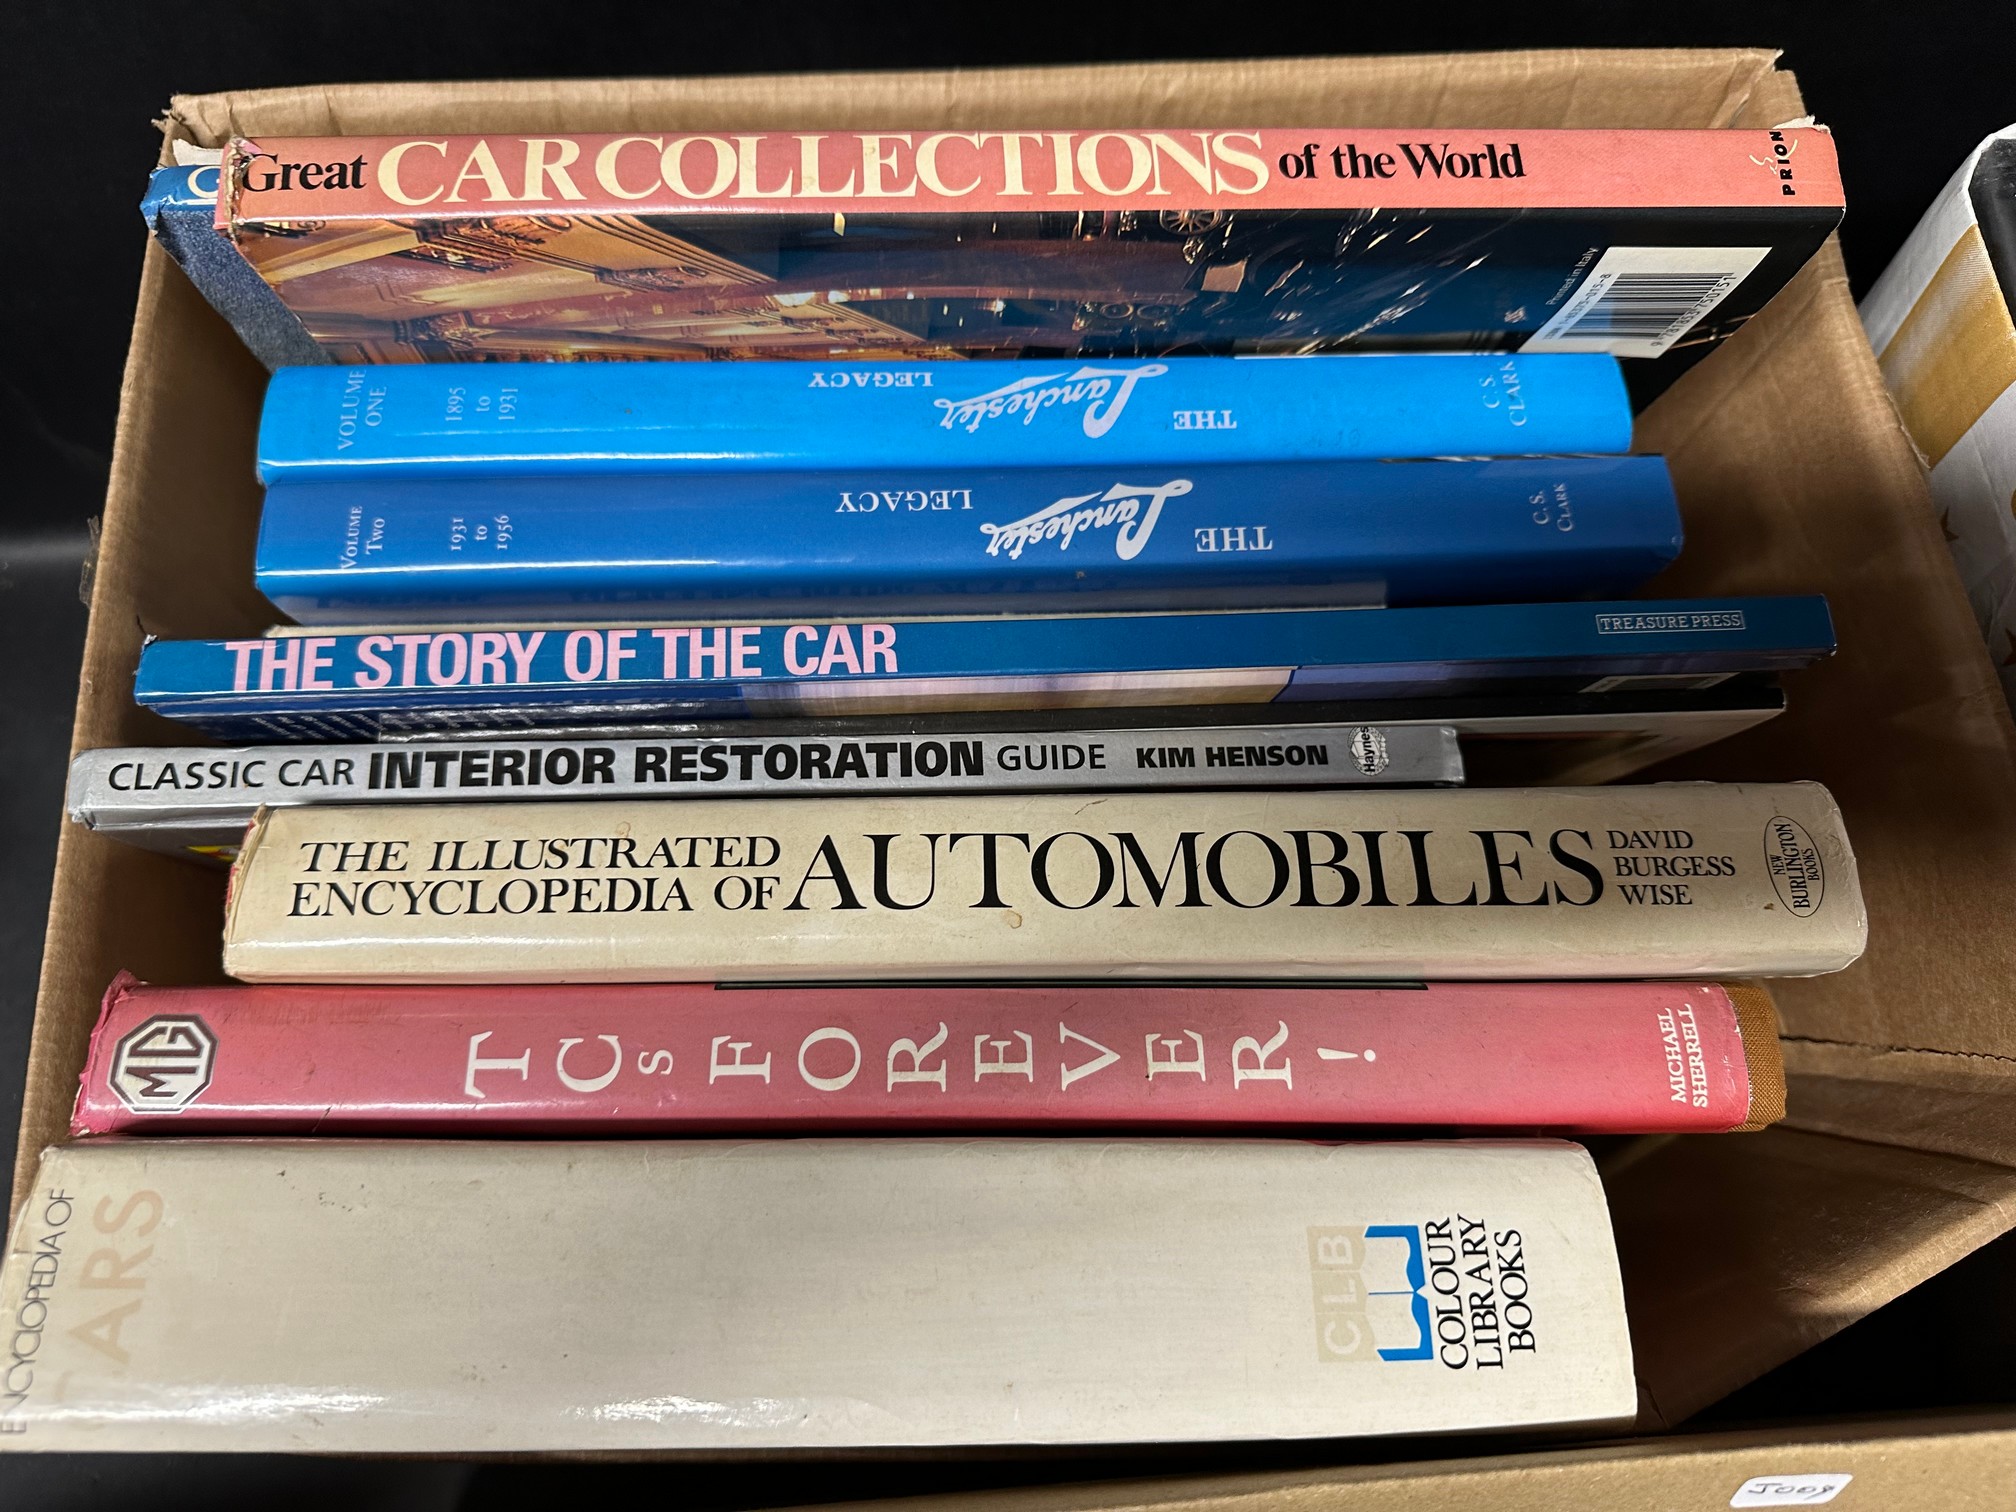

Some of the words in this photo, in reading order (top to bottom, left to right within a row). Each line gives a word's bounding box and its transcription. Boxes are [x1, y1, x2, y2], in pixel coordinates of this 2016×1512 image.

[240, 152, 368, 192] Great
[377, 137, 588, 206] CAR
[595, 132, 1270, 201] COLLECTIONS
[1279, 143, 1320, 180] of
[1331, 144, 1397, 180] the
[1398, 143, 1527, 180] World
[1768, 131, 1796, 196] PRION
[1545, 277, 1577, 306] Printed
[1575, 247, 1600, 267] Italy
[1693, 276, 1738, 308] 750151
[807, 372, 933, 388] LEGACY
[933, 363, 1169, 439] Lanchester
[1500, 360, 1528, 426] CLARK
[337, 369, 367, 451] VOLUME
[365, 386, 387, 427] ONE
[445, 386, 467, 422] 1895
[475, 395, 492, 412] to
[498, 387, 519, 421] 1931
[1172, 409, 1238, 431] THE
[835, 489, 974, 514] LEGACY
[979, 478, 1194, 560] Lanchester
[450, 517, 468, 552] 1931
[474, 524, 489, 541] to
[493, 514, 513, 551] 1956
[1194, 524, 1274, 552] THE
[1600, 615, 1689, 630] TREASURE
[1691, 614, 1742, 628] PRESS
[225, 637, 335, 692] THE
[354, 629, 549, 689] STORY
[563, 628, 639, 683] OF
[650, 625, 762, 680] THE
[783, 623, 899, 676] CAR
[107, 758, 266, 792] CLASSIC
[278, 757, 356, 788] CAR
[366, 745, 616, 790] INTERIOR
[633, 740, 985, 784] RESTORATION
[997, 743, 1107, 772] GUIDE
[1135, 745, 1197, 769] KIM
[1205, 744, 1329, 767] HENSON
[1360, 726, 1376, 773] Haynes
[299, 840, 411, 873] THE
[426, 836, 782, 873] ILLUSTRATED
[1606, 830, 1694, 850] DAVID
[782, 829, 1606, 912] AUTOMOBILES
[1613, 856, 1736, 877] BURGESS
[1768, 854, 1787, 876] NEW
[1773, 823, 1811, 909] BURLINGTON
[1801, 848, 1820, 881] BOOKS
[286, 876, 694, 918] ENCYCLOPEDIA
[713, 874, 782, 911] OF
[1617, 884, 1693, 906] WISE
[124, 1025, 205, 1098] MG
[1656, 1007, 1688, 1104] MICHAEL
[1676, 1003, 1709, 1108] SHERRELL
[44, 1188, 75, 1227] OF
[1318, 1234, 1361, 1355] CLB
[1424, 1216, 1470, 1370] COLOUR
[1457, 1212, 1504, 1371] LIBRARY
[1493, 1229, 1537, 1354] BOOKS
